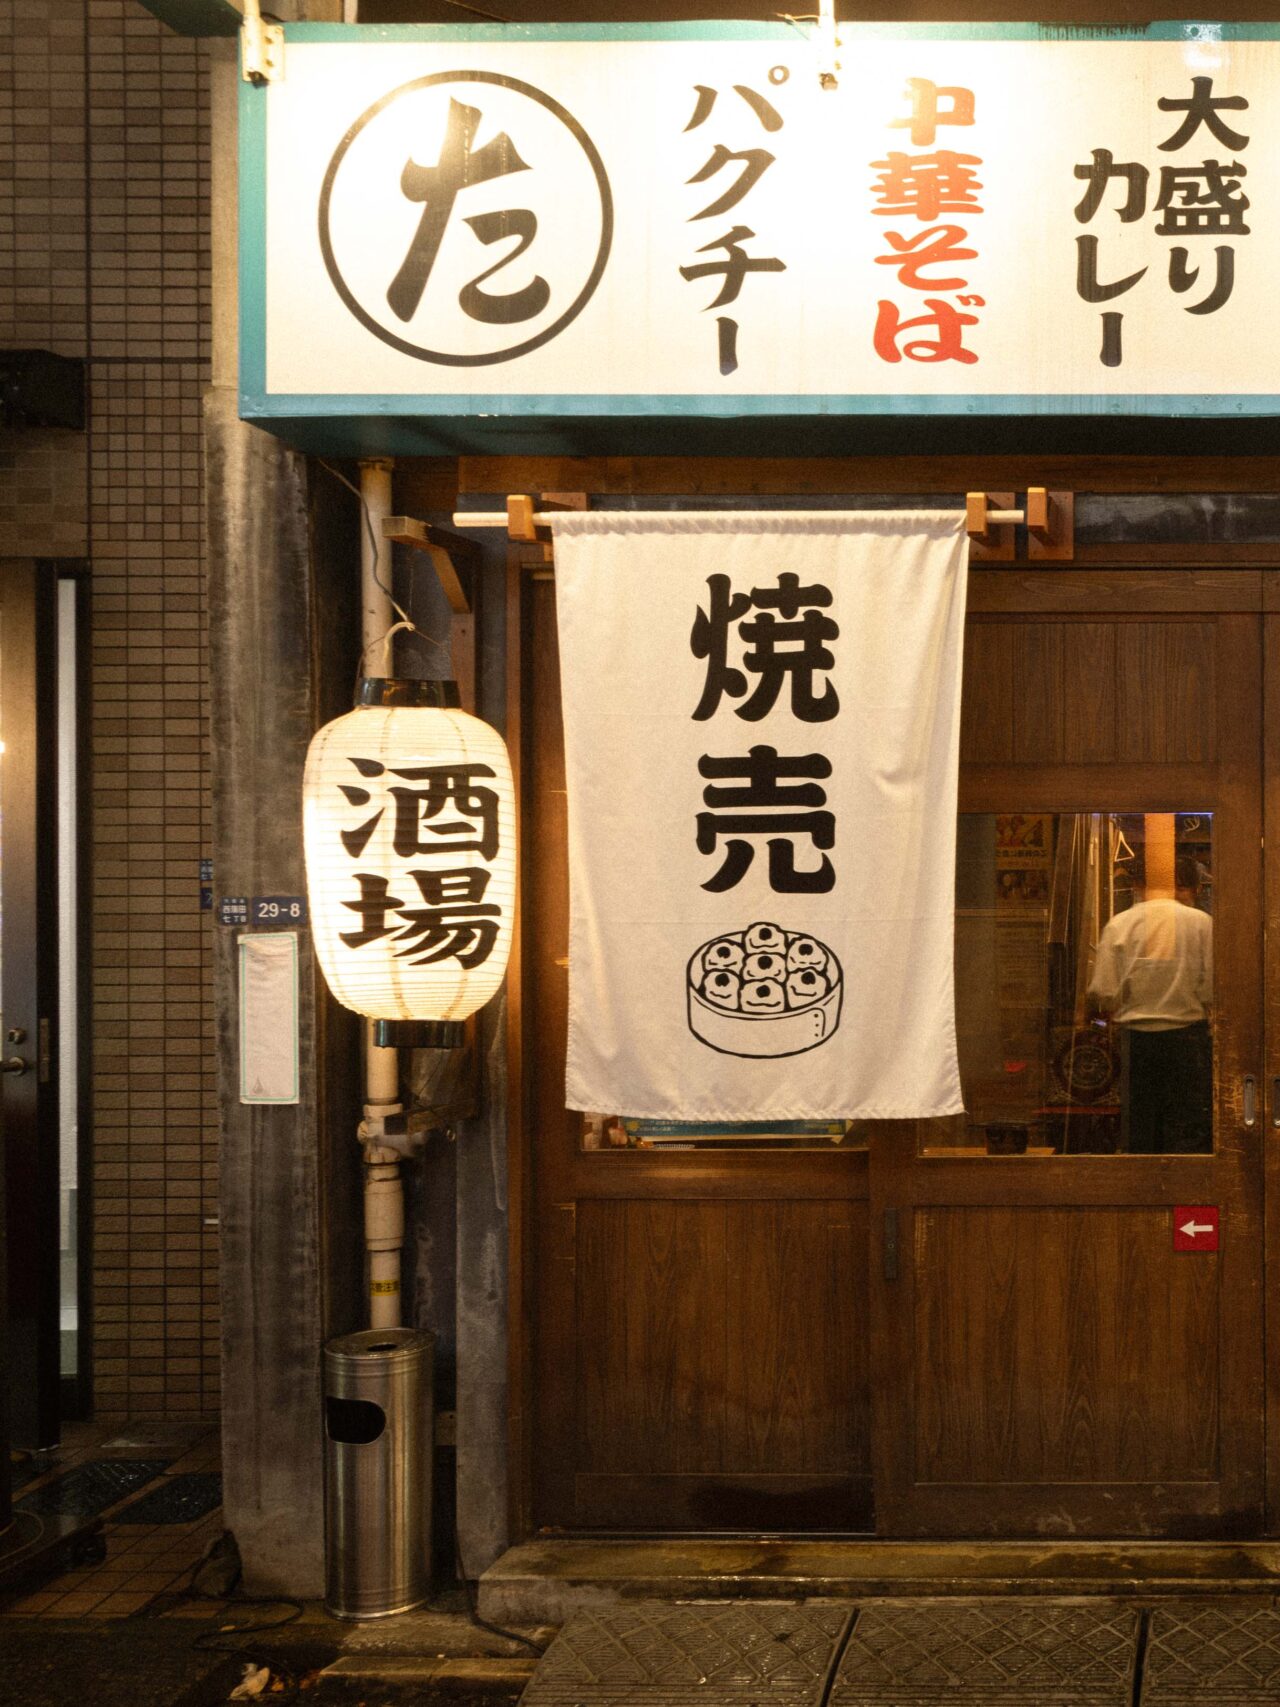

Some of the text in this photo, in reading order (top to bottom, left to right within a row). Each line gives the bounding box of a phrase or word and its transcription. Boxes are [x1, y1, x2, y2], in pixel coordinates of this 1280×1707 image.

[386, 96, 551, 325] た
[679, 65, 790, 376] パクチー
[869, 76, 987, 365] 中華そば
[1073, 148, 1150, 368] カレー
[1152, 75, 1251, 315] 大盛り
[689, 571, 841, 894] 焼売
[258, 902, 301, 918] 29-8
[336, 757, 502, 970] 酒場
